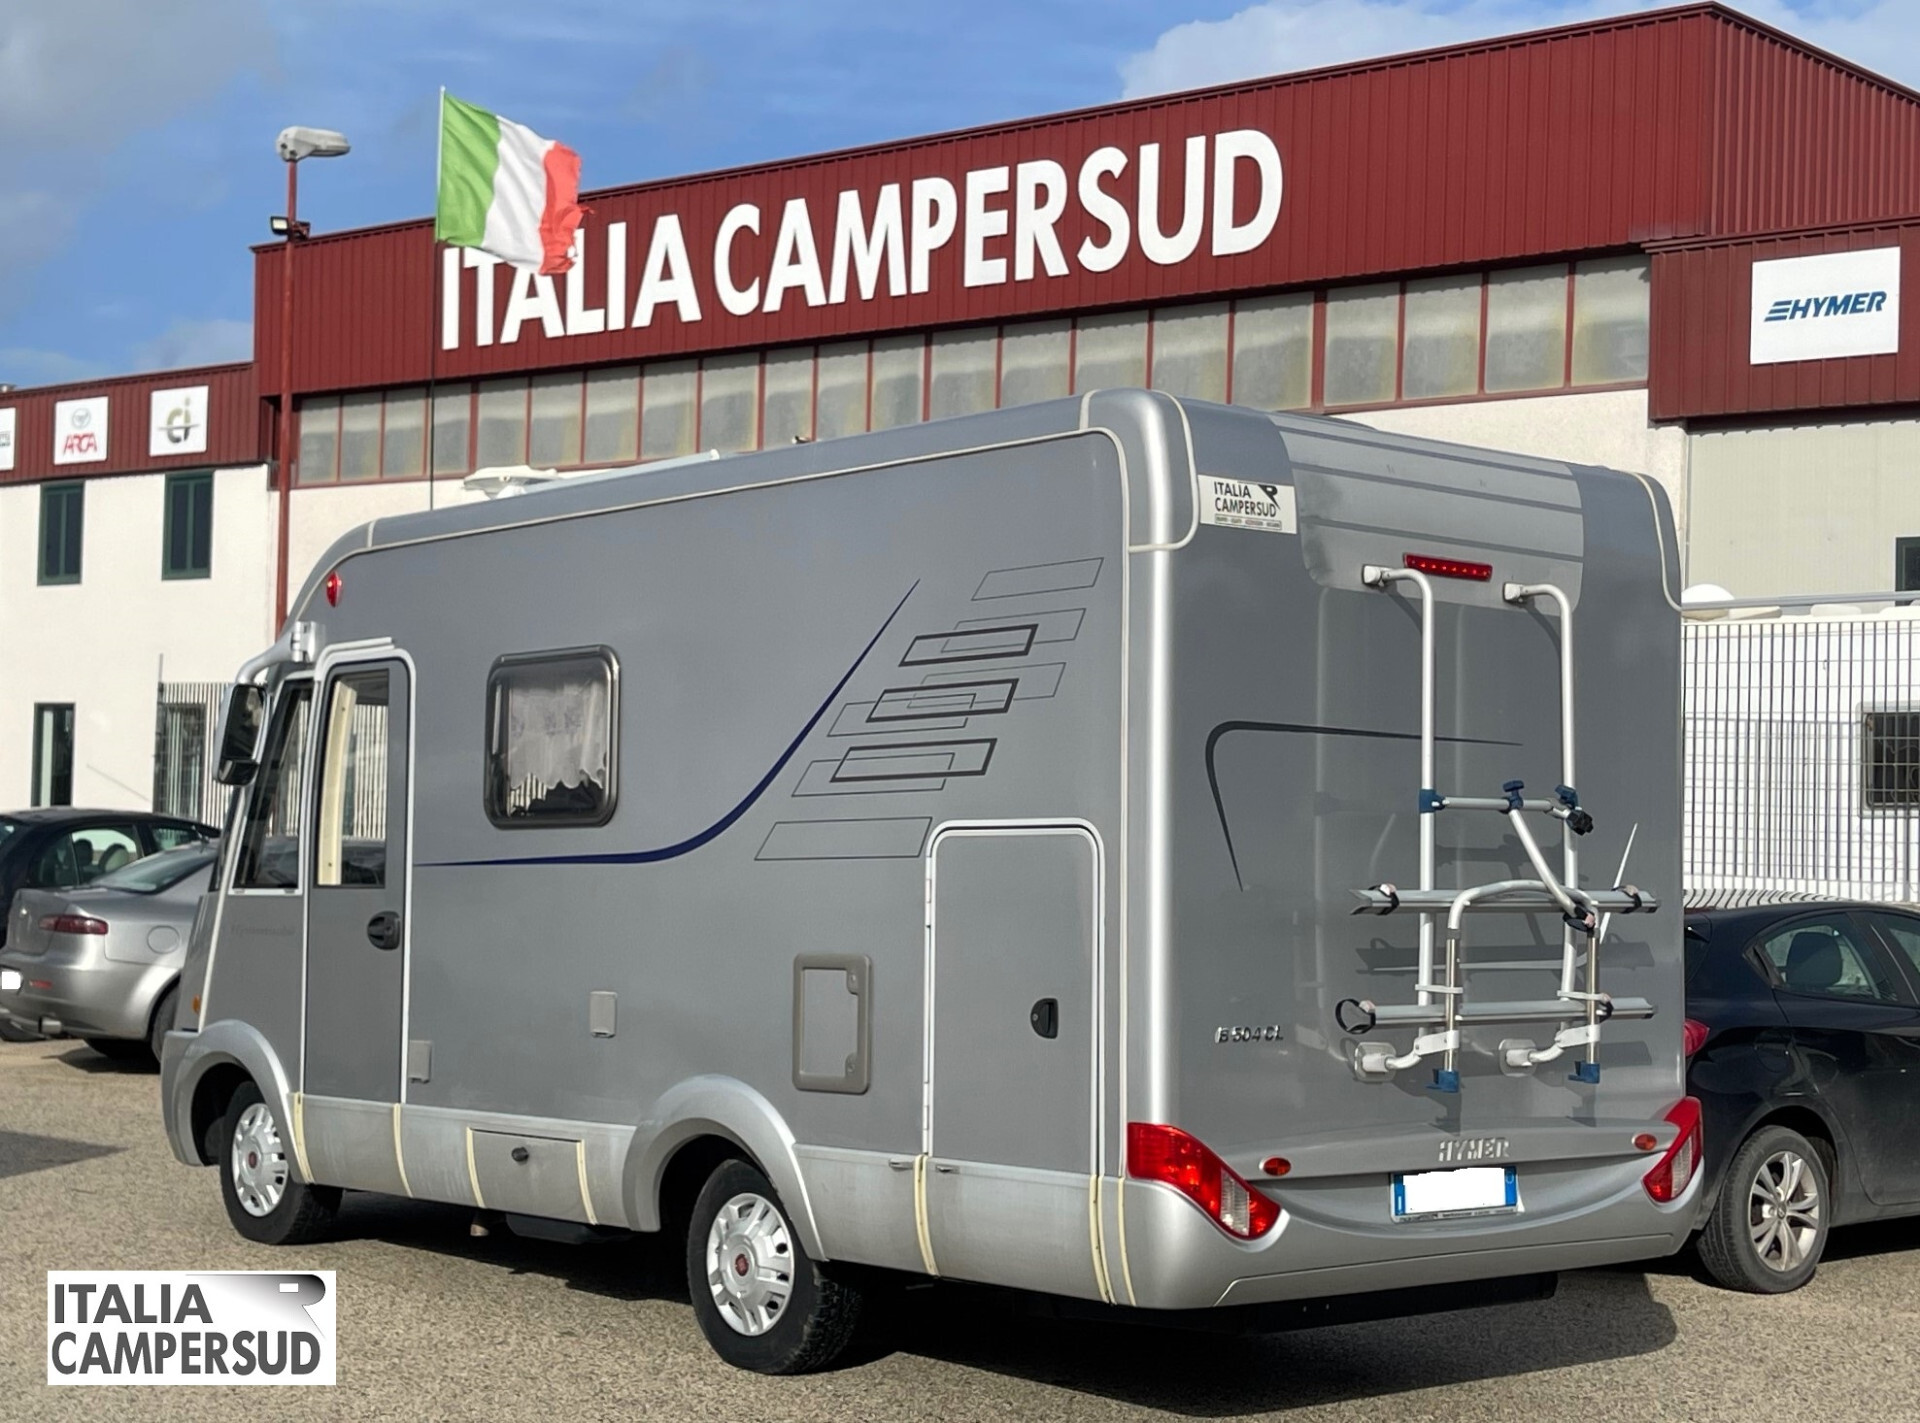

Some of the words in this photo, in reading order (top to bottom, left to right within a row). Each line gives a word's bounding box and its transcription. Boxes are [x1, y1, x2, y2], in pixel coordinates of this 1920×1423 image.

[441, 213, 703, 350] ITALIA
[713, 129, 1284, 317] CAMPERSUD
[1788, 290, 1888, 320] HYMER
[62, 432, 98, 456] ARCA
[1213, 481, 1252, 499] ITALIA
[1215, 497, 1277, 518] CAMPERSUD
[1438, 1137, 1511, 1162] HYMER
